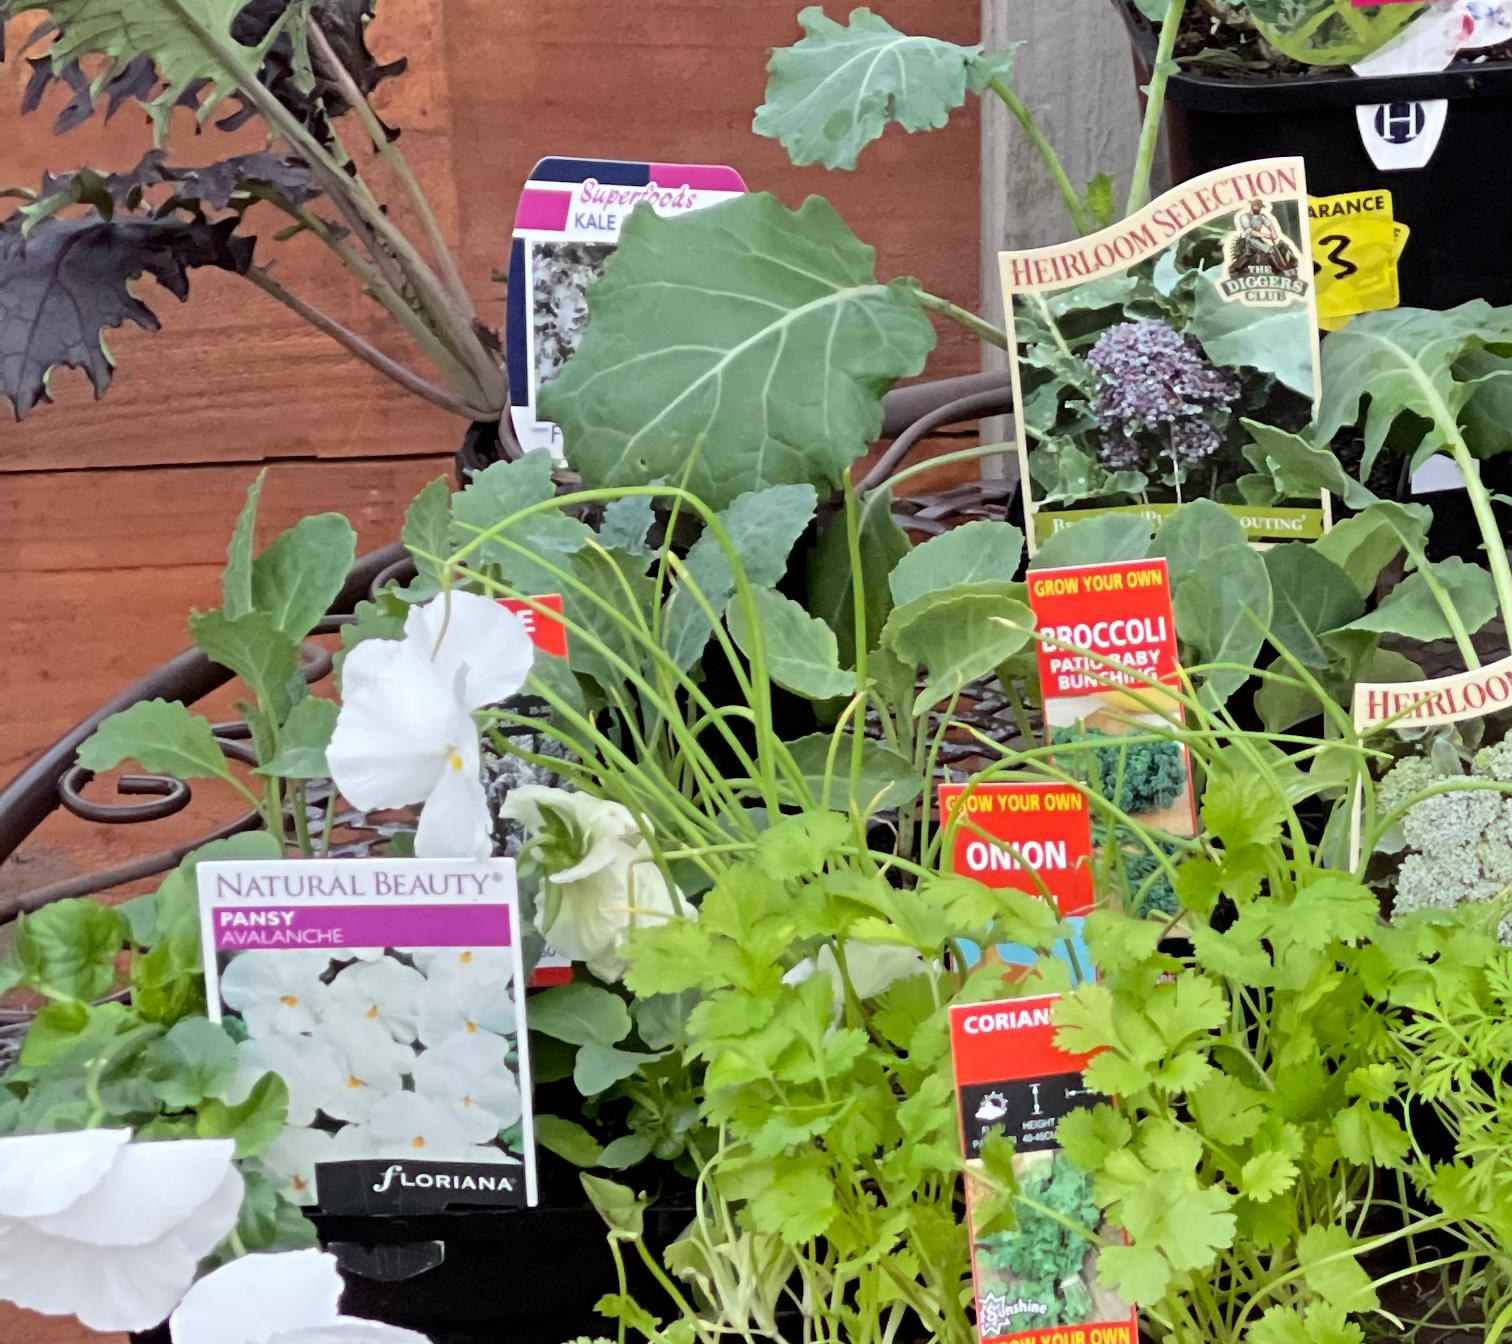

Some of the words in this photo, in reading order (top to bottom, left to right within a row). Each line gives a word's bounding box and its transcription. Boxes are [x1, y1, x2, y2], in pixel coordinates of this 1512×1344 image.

[580, 180, 698, 212] Superfoods
[1308, 195, 1385, 218] ARANCE
[574, 212, 617, 231] KALE
[1010, 223, 1159, 287] HEIRLOOM
[1150, 166, 1299, 238] SELECTION
[1247, 265, 1273, 274] THE
[1226, 275, 1304, 294] DIGGERS
[1239, 514, 1307, 532] OUTING'
[1033, 577, 1080, 598] GROW
[1081, 572, 1124, 593] YOUR
[1126, 568, 1163, 588] OWN
[1039, 615, 1167, 653] BROCCOLI
[996, 793, 1041, 812] YOUR
[1044, 792, 1083, 811] OWN
[966, 840, 1067, 871] ONION
[215, 872, 367, 899] NATURAL
[219, 910, 296, 927] PANSY
[220, 928, 344, 945] AVALANCHE
[963, 1007, 1052, 1035] CORIAN
[984, 1297, 1048, 1324] Sunshine
